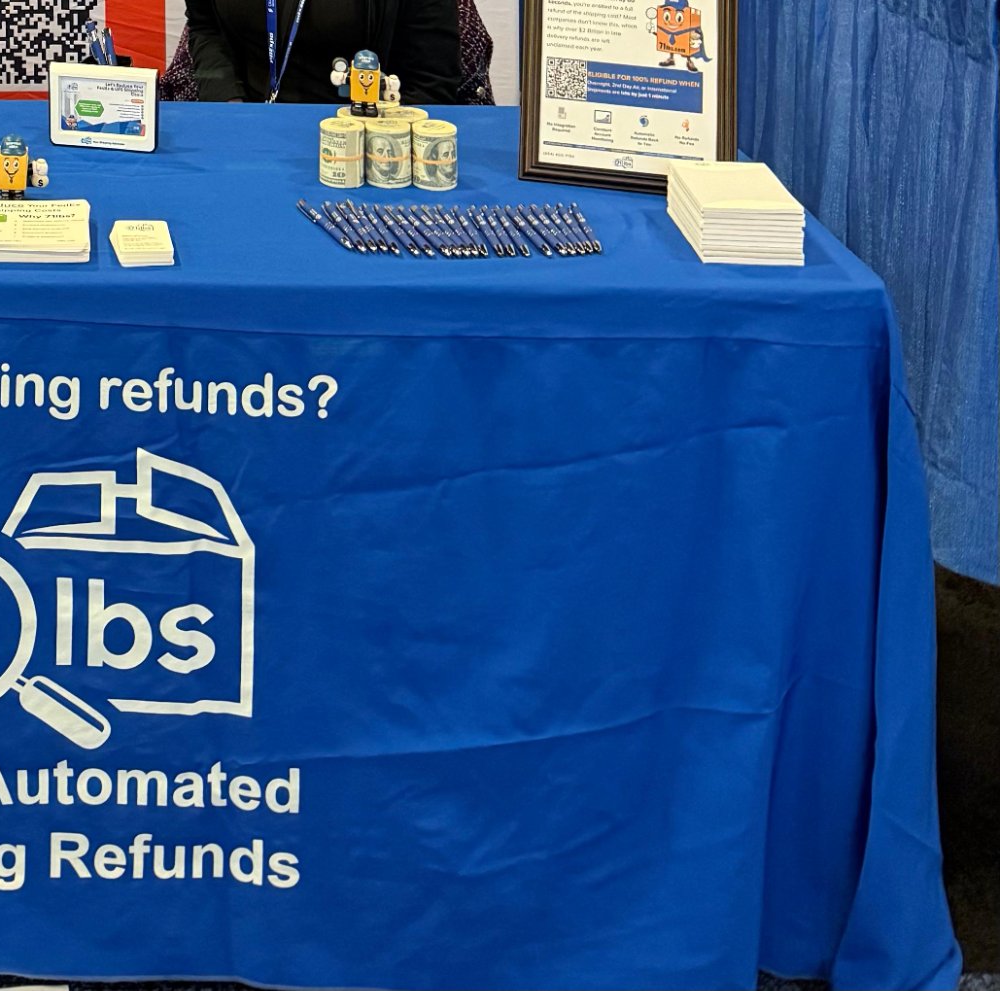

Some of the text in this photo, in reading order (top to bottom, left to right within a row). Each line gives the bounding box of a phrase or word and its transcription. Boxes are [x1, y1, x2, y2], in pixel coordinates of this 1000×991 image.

[99, 367, 339, 419] refunds?
[54, 577, 216, 674] lbs
[49, 832, 301, 889] Refunds
